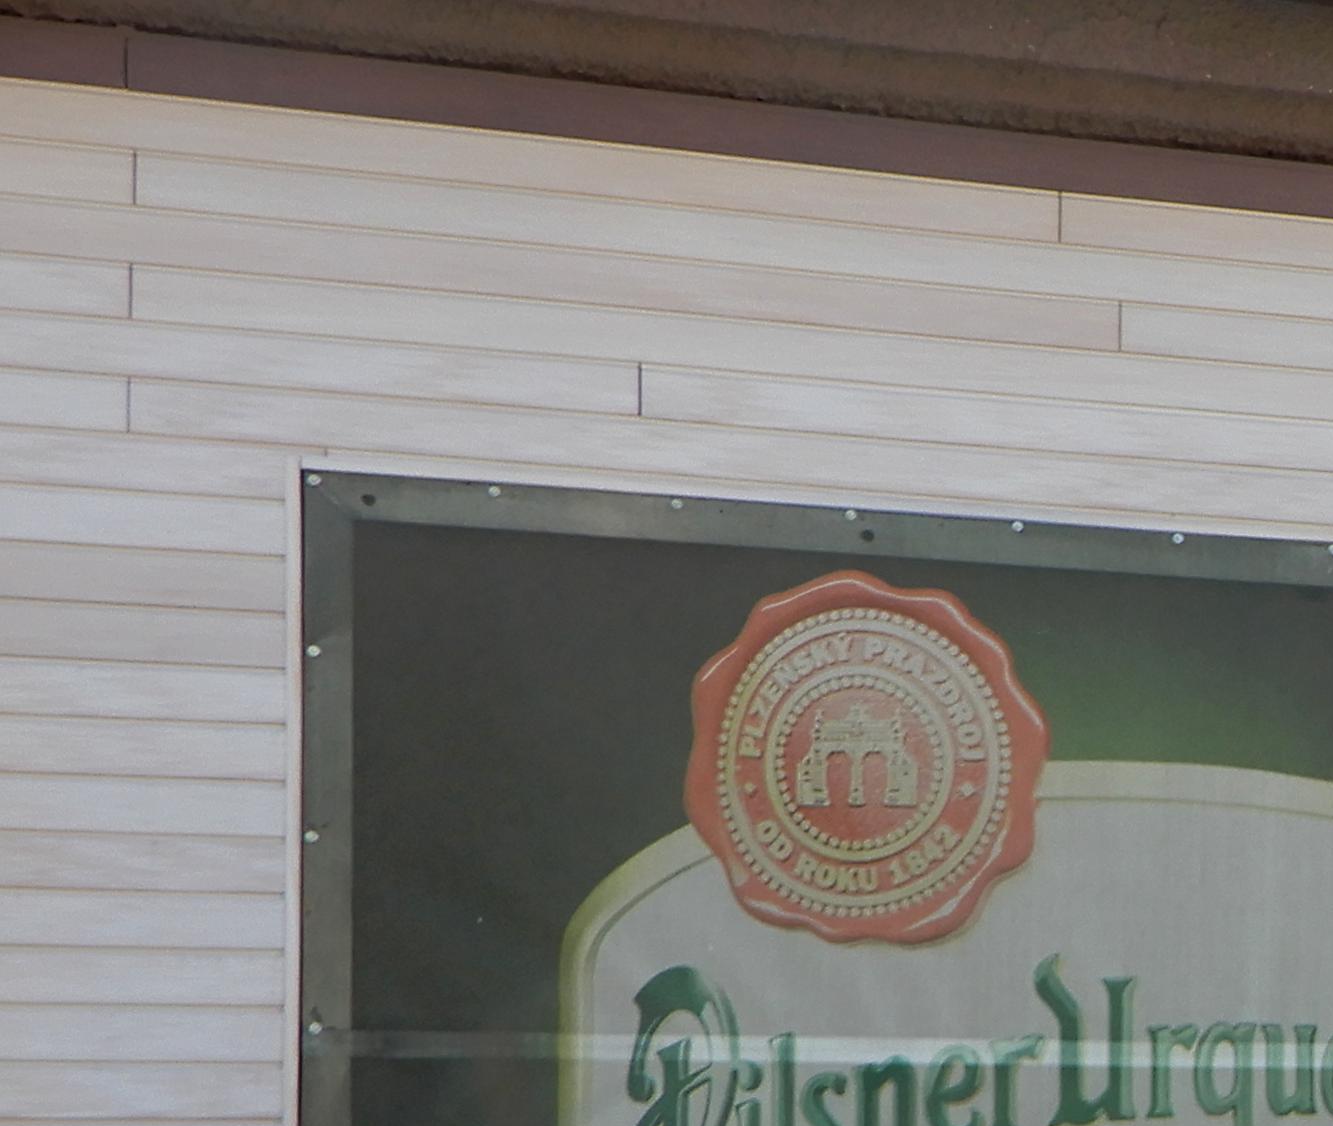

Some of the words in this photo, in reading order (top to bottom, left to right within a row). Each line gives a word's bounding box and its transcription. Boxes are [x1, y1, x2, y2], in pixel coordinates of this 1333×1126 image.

[862, 640, 985, 763] PRAZDROJ
[757, 819, 792, 863] OD
[796, 856, 881, 892] ROKU
[889, 828, 961, 885] 1842
